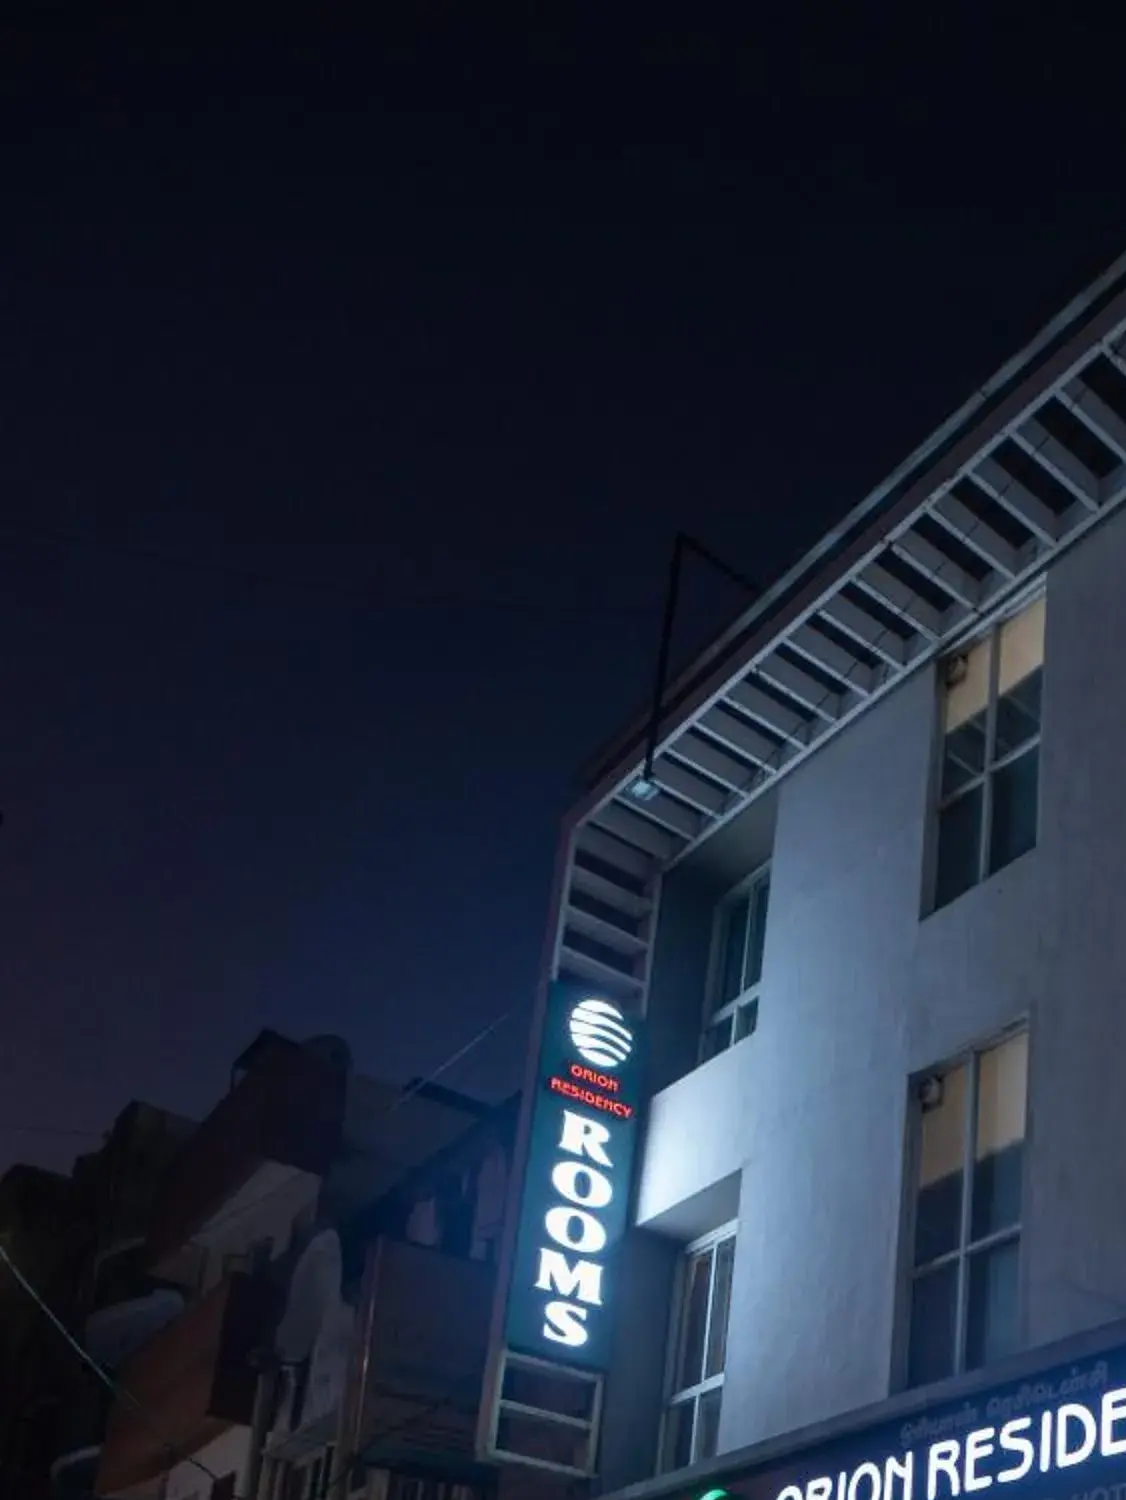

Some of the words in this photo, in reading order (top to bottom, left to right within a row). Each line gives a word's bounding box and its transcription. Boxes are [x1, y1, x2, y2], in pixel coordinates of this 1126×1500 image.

[551, 1077, 633, 1118] RESIDENCY
[570, 1063, 620, 1092] ORION
[535, 1108, 614, 1347] ROOMS
